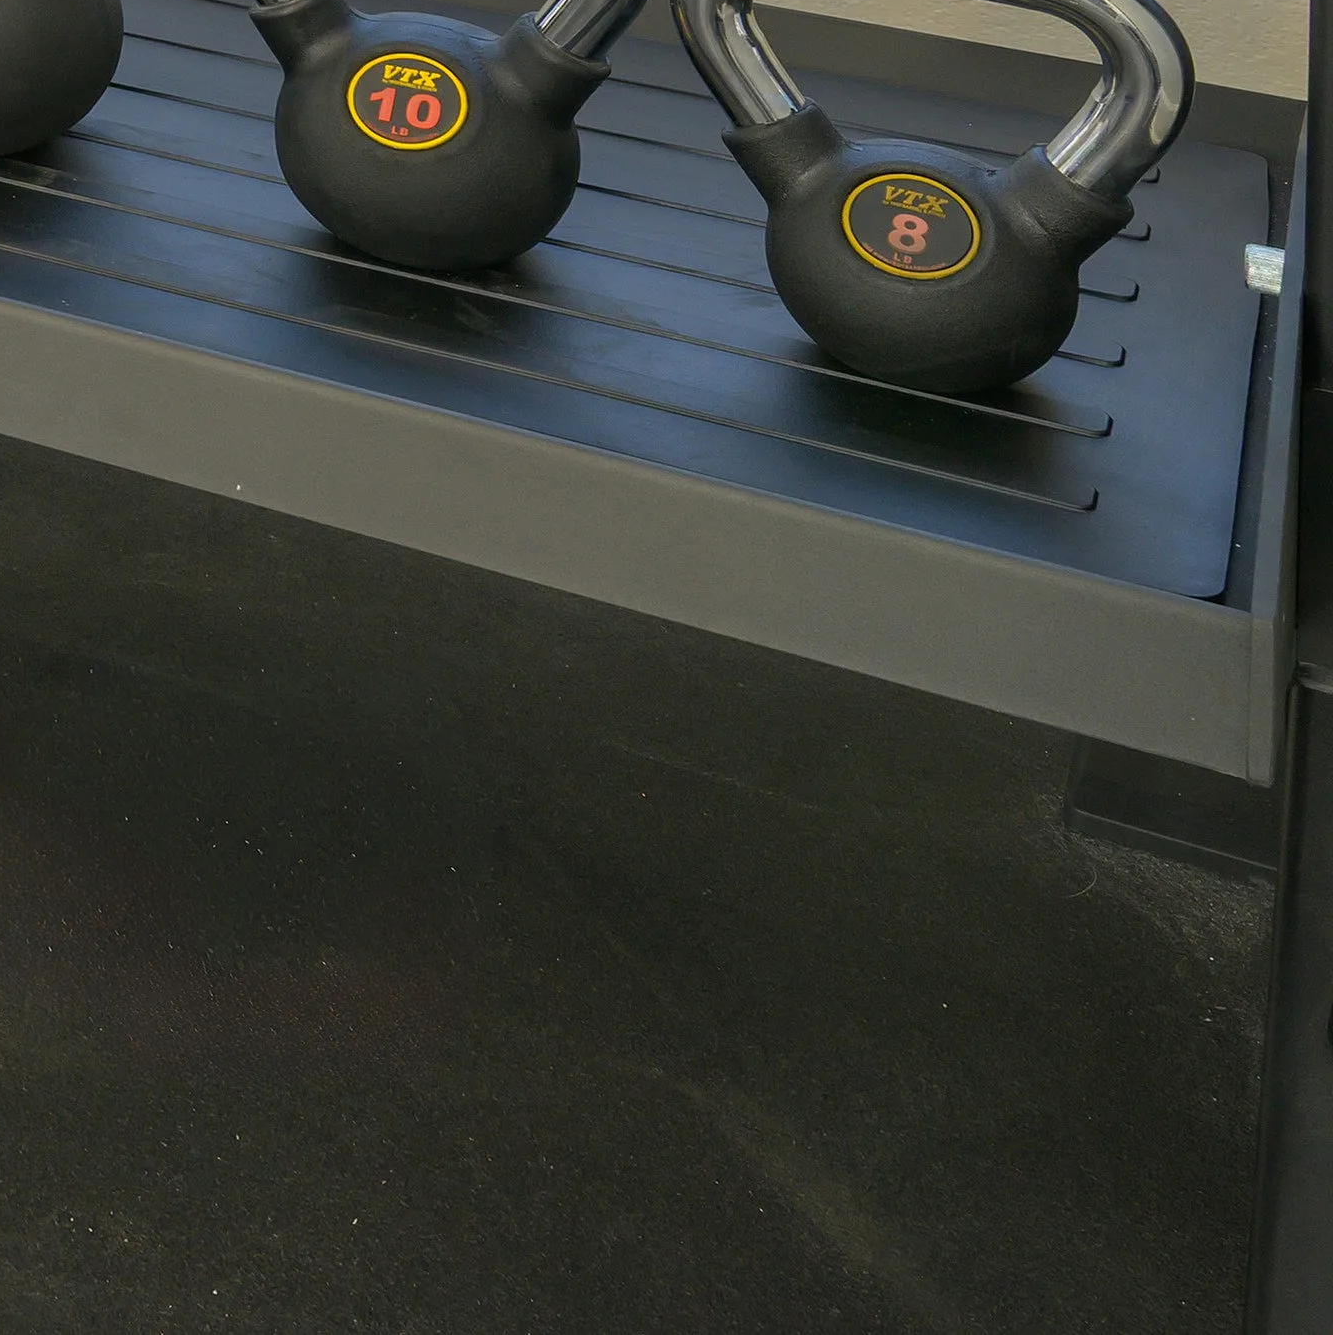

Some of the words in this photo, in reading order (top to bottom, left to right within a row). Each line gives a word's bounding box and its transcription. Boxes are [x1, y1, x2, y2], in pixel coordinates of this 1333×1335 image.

[383, 64, 441, 88] VTX
[370, 87, 442, 130] 10
[391, 126, 409, 136] LB
[885, 185, 948, 213] VTX
[887, 213, 930, 255] 8
